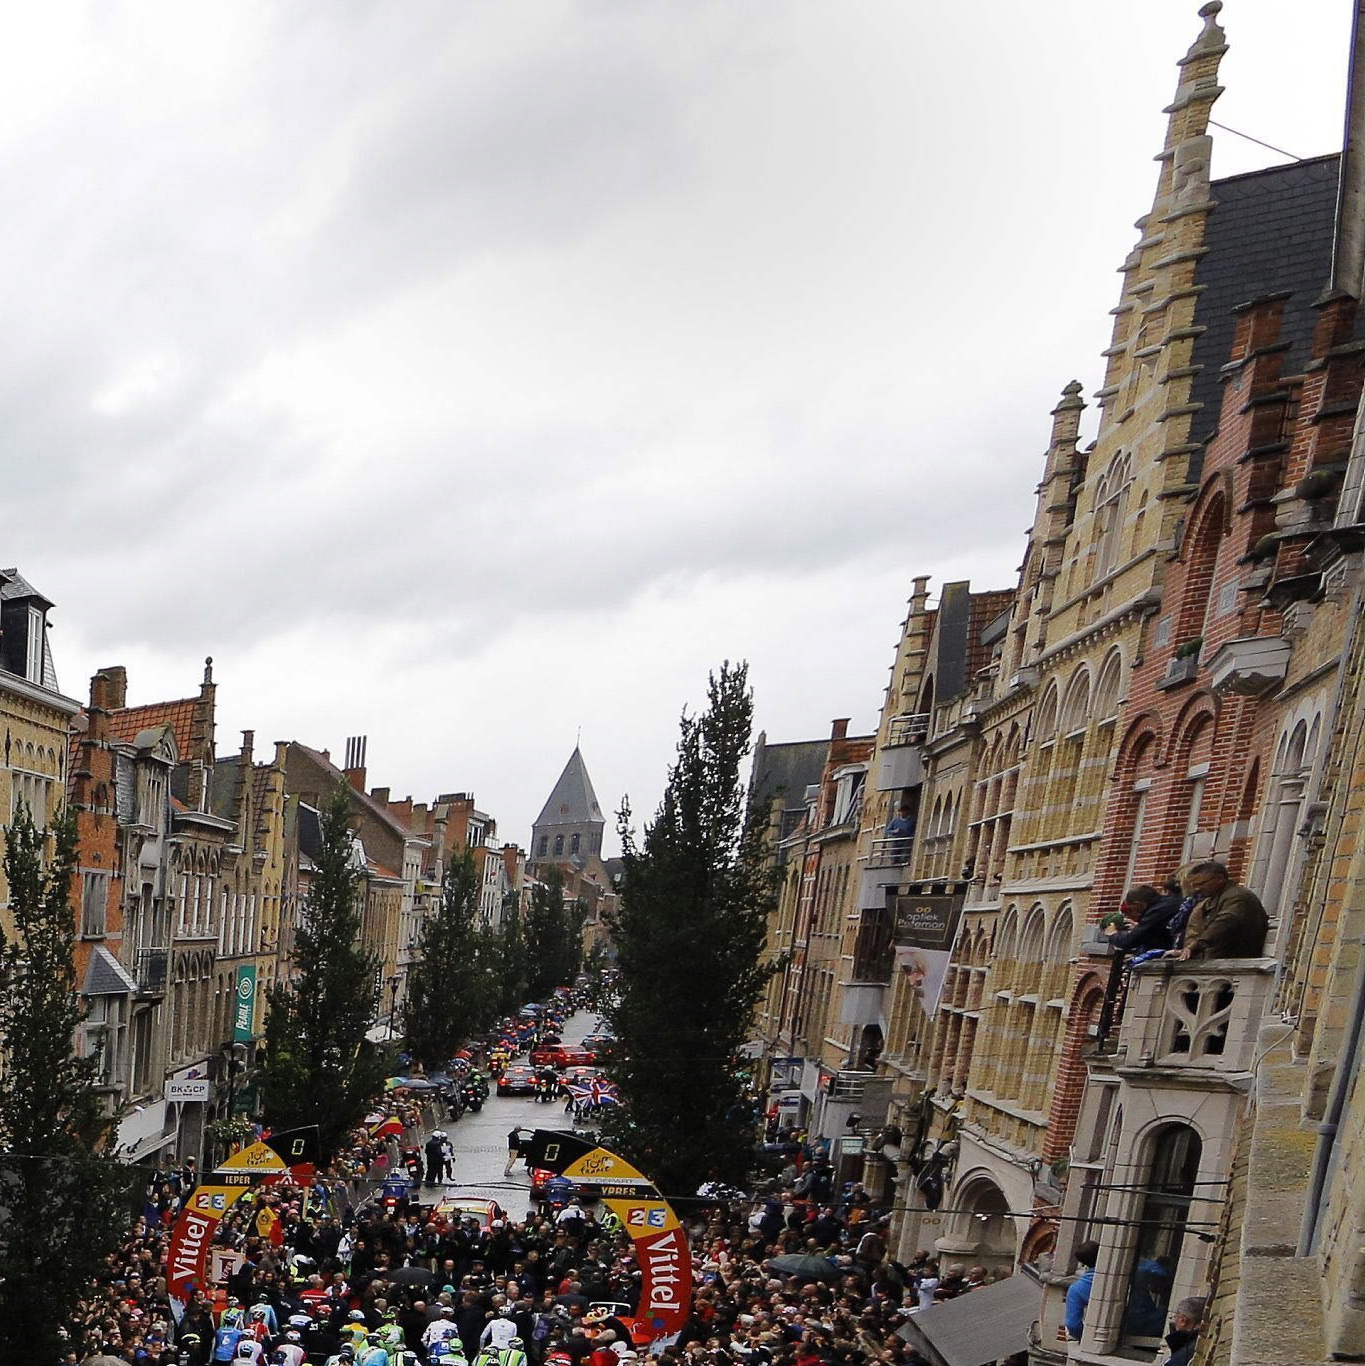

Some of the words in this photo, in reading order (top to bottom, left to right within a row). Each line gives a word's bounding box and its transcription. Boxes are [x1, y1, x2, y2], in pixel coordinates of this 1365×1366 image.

[225, 1175, 251, 1185] IEPER
[172, 1212, 210, 1281] Vittel
[647, 1232, 682, 1309] Vittel
